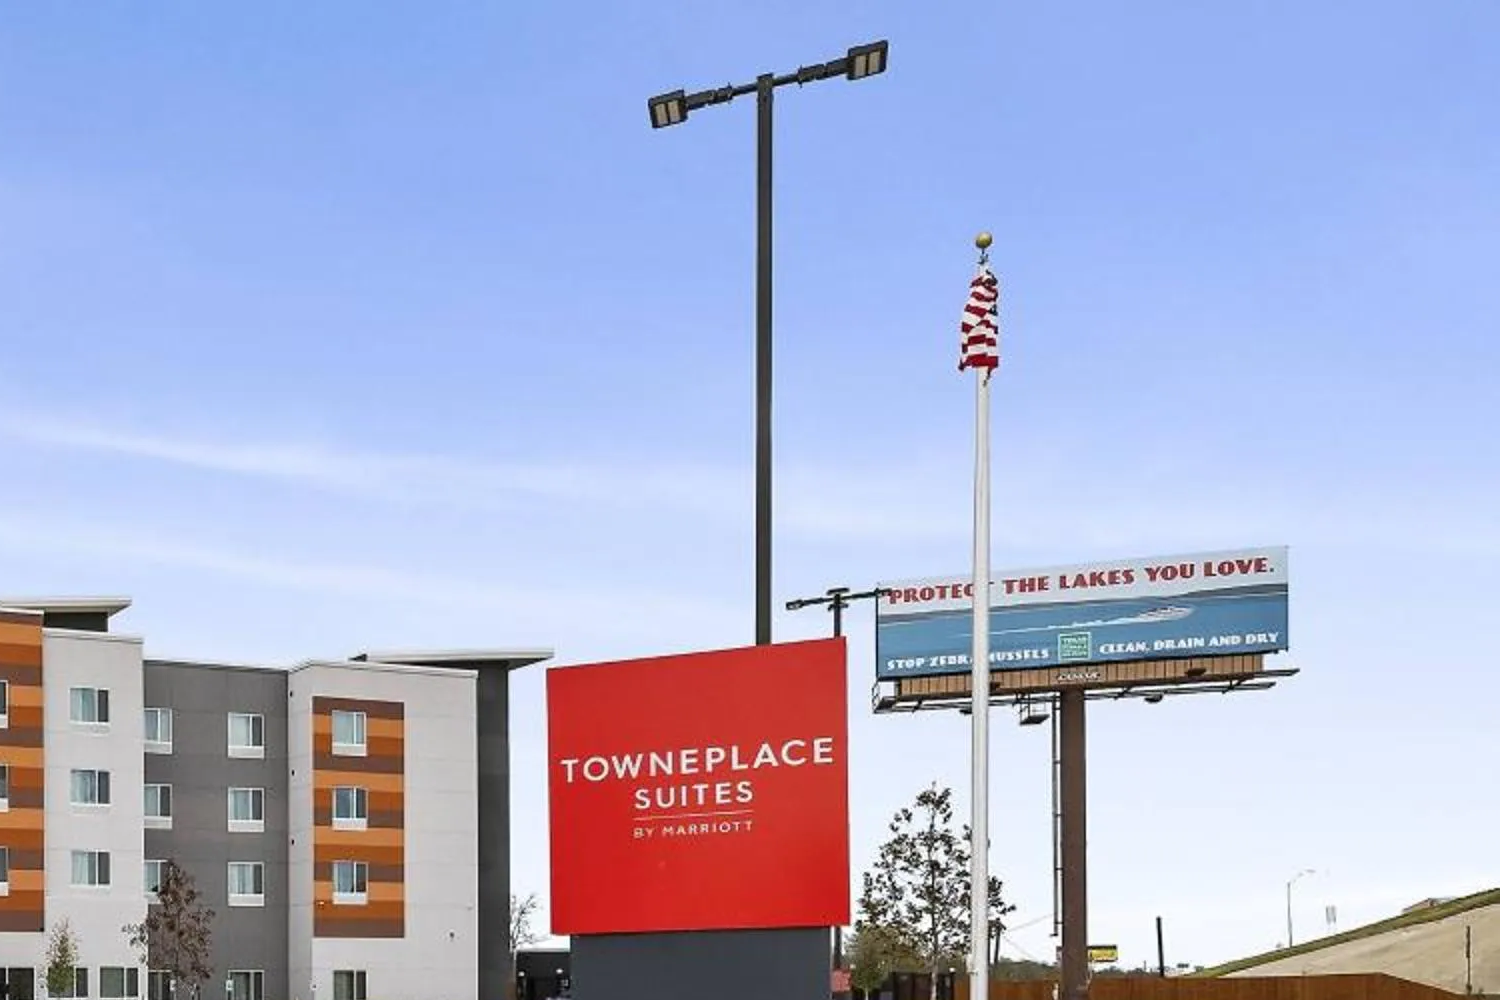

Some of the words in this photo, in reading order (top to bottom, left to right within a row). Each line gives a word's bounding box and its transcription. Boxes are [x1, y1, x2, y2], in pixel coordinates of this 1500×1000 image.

[887, 583, 995, 604] PROTEC
[1002, 576, 1050, 594] THE
[1059, 569, 1134, 589] LAKES
[1145, 563, 1195, 581] YOU
[1204, 557, 1275, 577] LOVE.
[1154, 637, 1205, 651] DRAIN
[1208, 635, 1241, 647] AND
[1245, 631, 1279, 645] DRY
[887, 657, 925, 670] STOP
[930, 655, 973, 667] ZEBR
[561, 737, 834, 783] TOWNEPLACE
[634, 780, 754, 810] SUITES
[634, 827, 655, 839] BY
[662, 820, 753, 837] MARRIOTT
